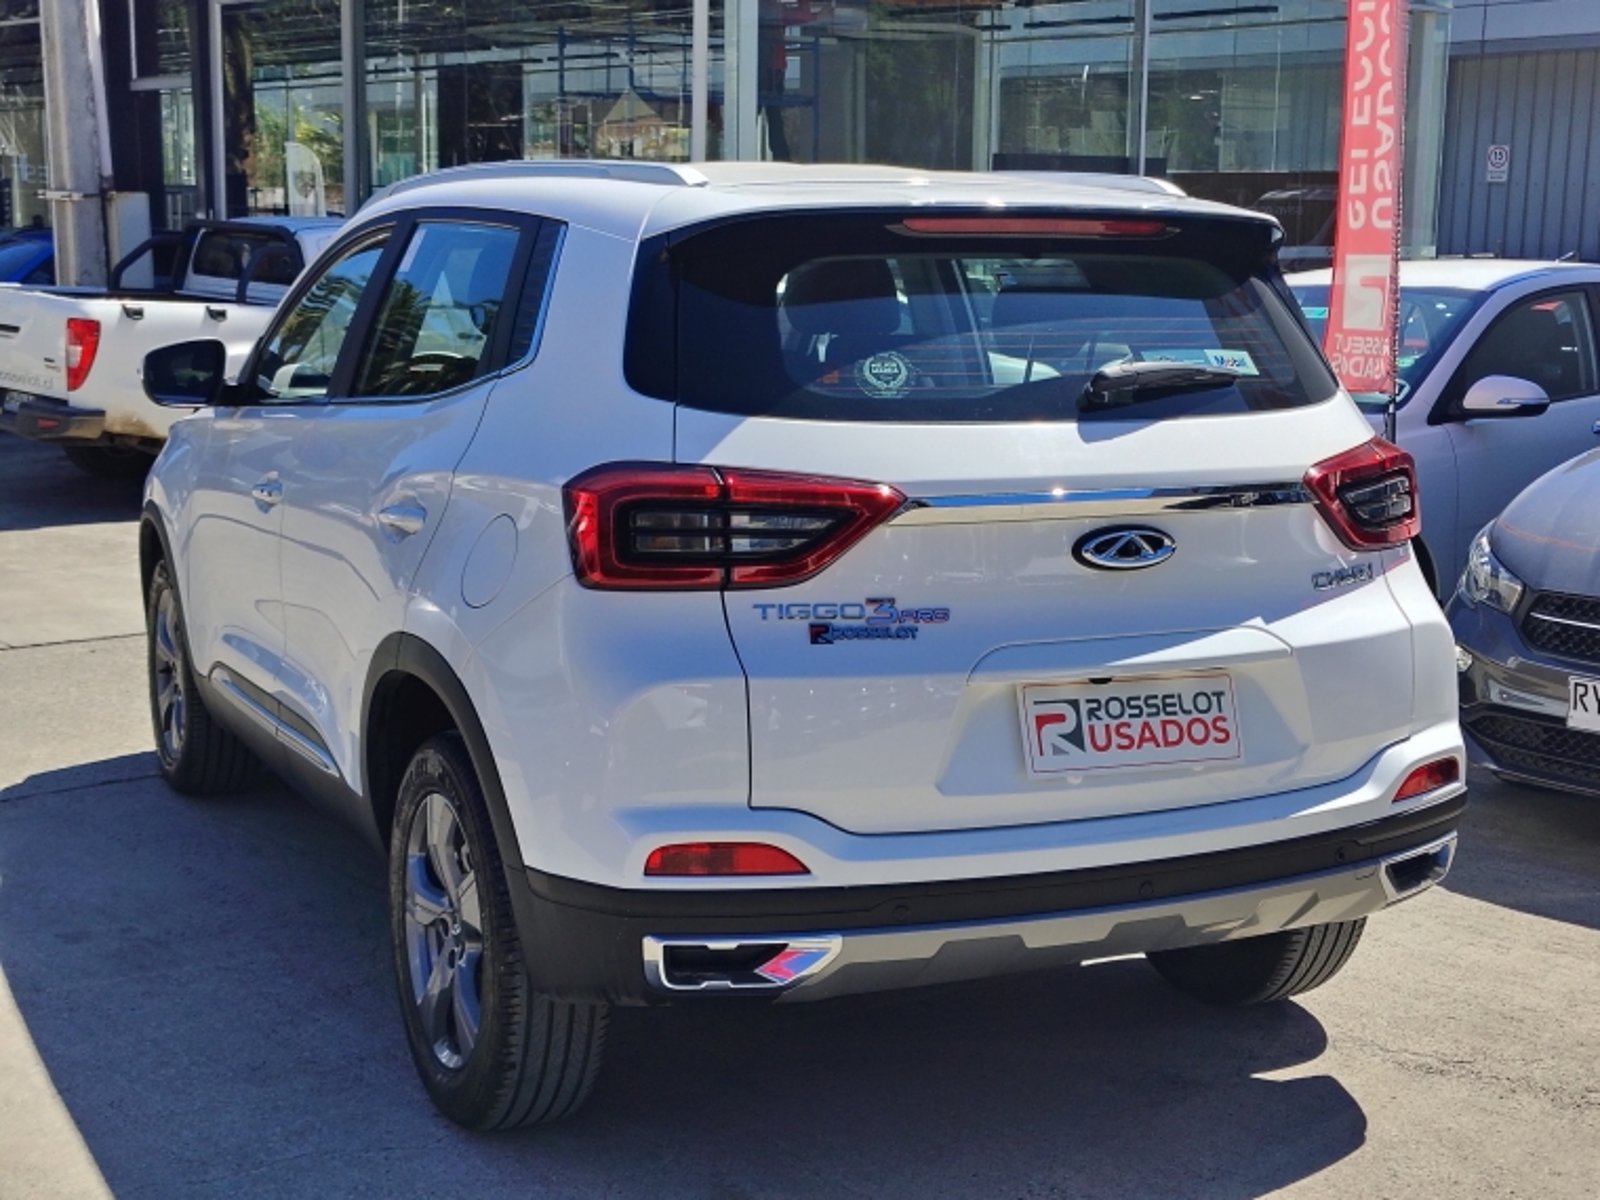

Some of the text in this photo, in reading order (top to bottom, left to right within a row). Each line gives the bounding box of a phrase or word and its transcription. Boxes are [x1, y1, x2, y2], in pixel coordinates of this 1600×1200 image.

[752, 603, 866, 620] TIGGO
[865, 597, 899, 626] 3
[1085, 690, 1226, 722] ROSSELOT
[1088, 715, 1231, 753] USADOS
